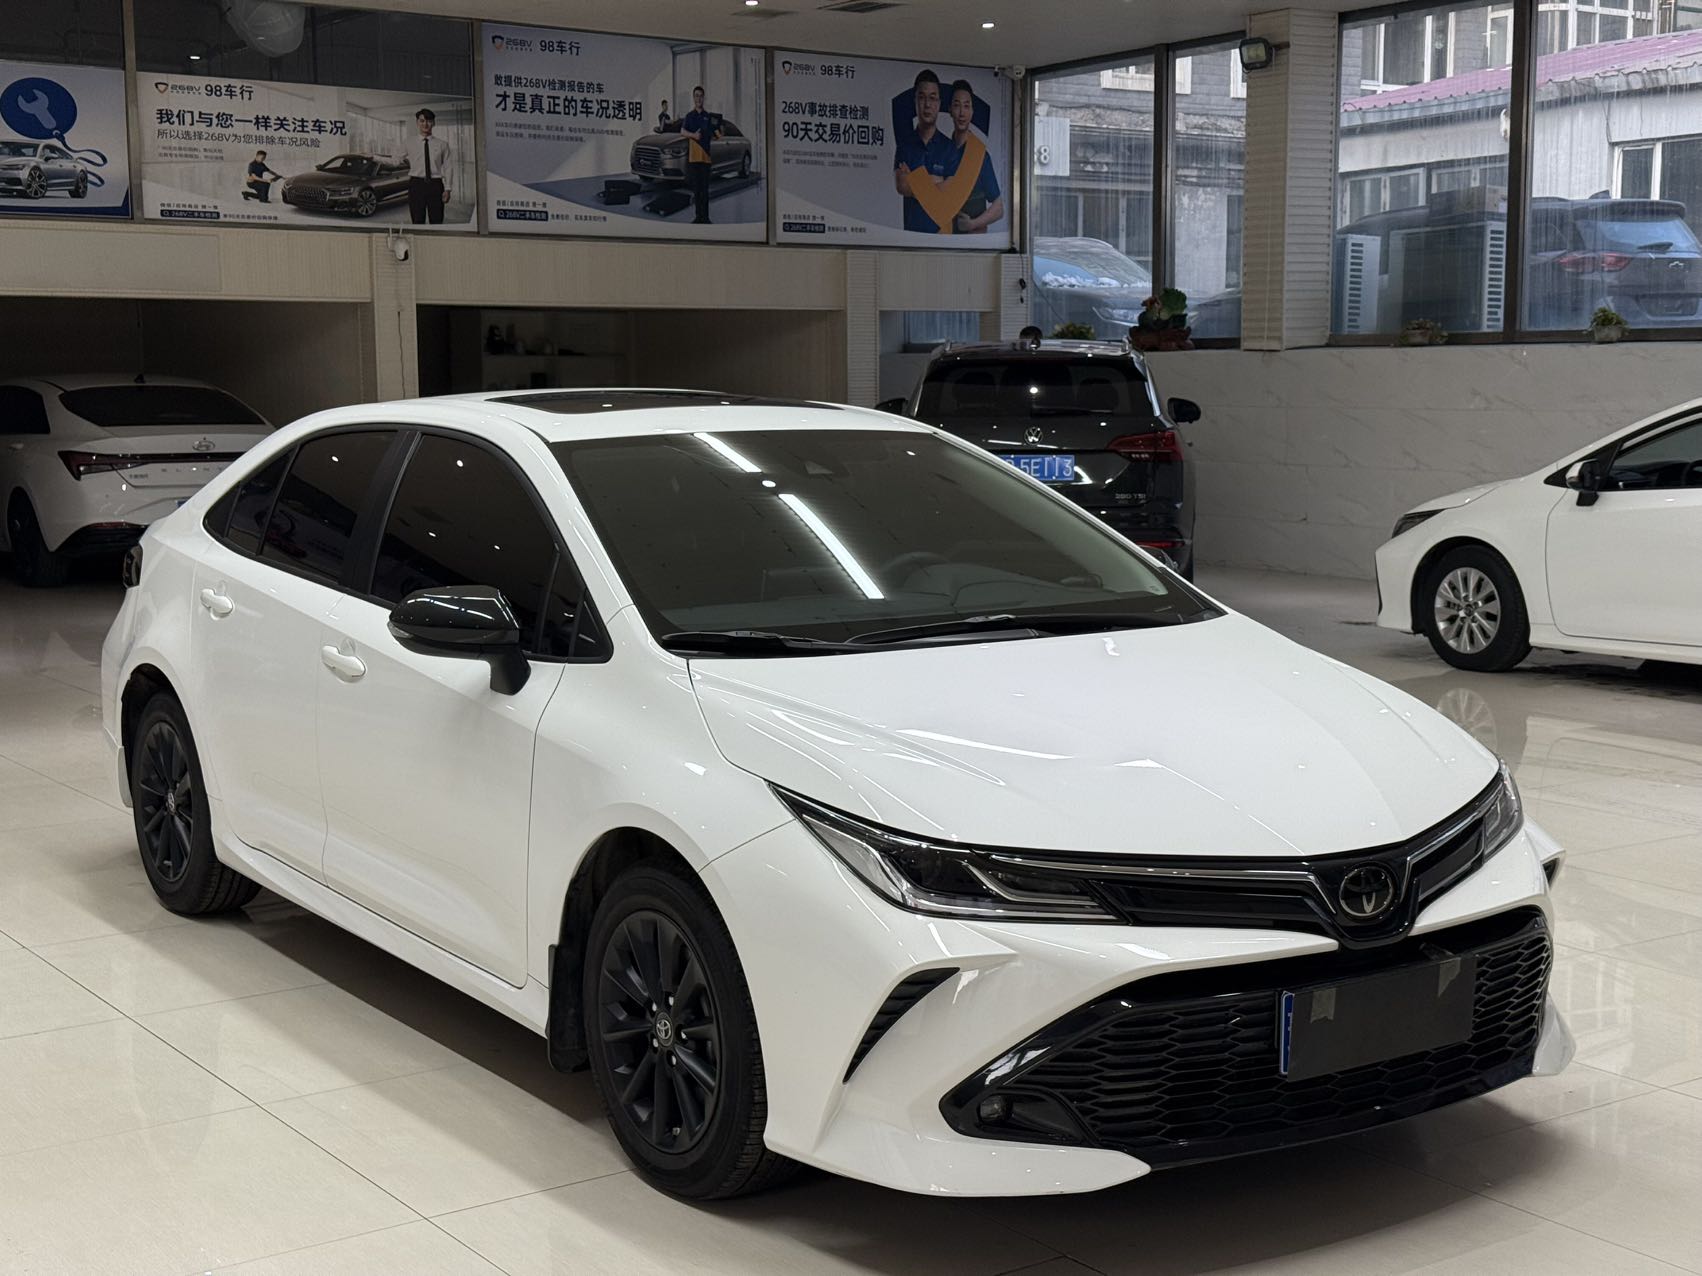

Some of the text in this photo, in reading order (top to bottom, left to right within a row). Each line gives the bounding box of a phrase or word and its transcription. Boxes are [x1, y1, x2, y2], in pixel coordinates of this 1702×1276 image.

[540, 39, 581, 56] 98车行
[820, 64, 856, 79] 98车行
[204, 84, 254, 101] 98车行
[494, 74, 604, 93] 敢提供268V检测报告的车
[495, 92, 642, 121] 才是真正的车况透明
[782, 101, 869, 120] 268V事故排查检测
[156, 108, 347, 136] 我们与您一样关注车况
[156, 129, 321, 148] 所以选择268V为您排除车况风险
[782, 121, 884, 146] 90天交易价回购
